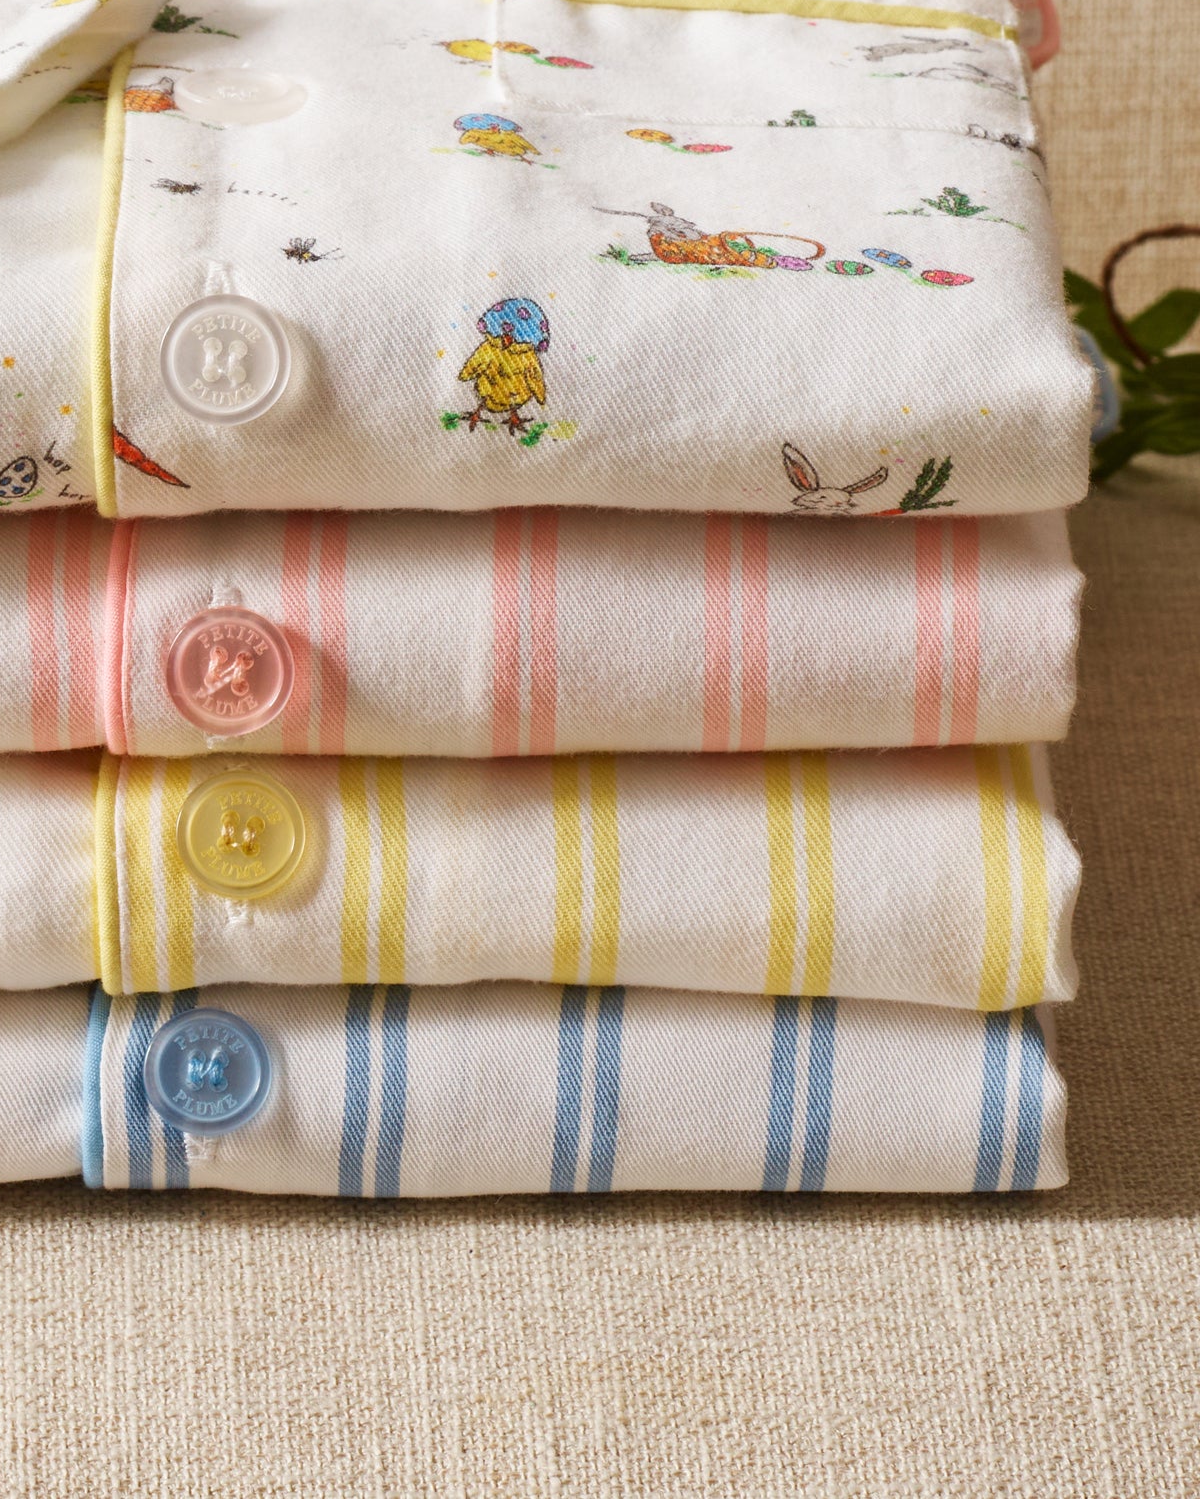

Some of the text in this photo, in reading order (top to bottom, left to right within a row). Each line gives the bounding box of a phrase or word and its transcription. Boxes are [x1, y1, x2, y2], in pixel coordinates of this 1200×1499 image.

[191, 314, 262, 343] PETITE
[188, 378, 257, 407] PLUME
[43, 440, 72, 475] hop
[198, 624, 268, 656] PETITE
[216, 790, 282, 824] PETITE
[201, 846, 266, 879] PLUME
[174, 1023, 245, 1054] PETITE
[172, 1089, 239, 1116] PLUME
